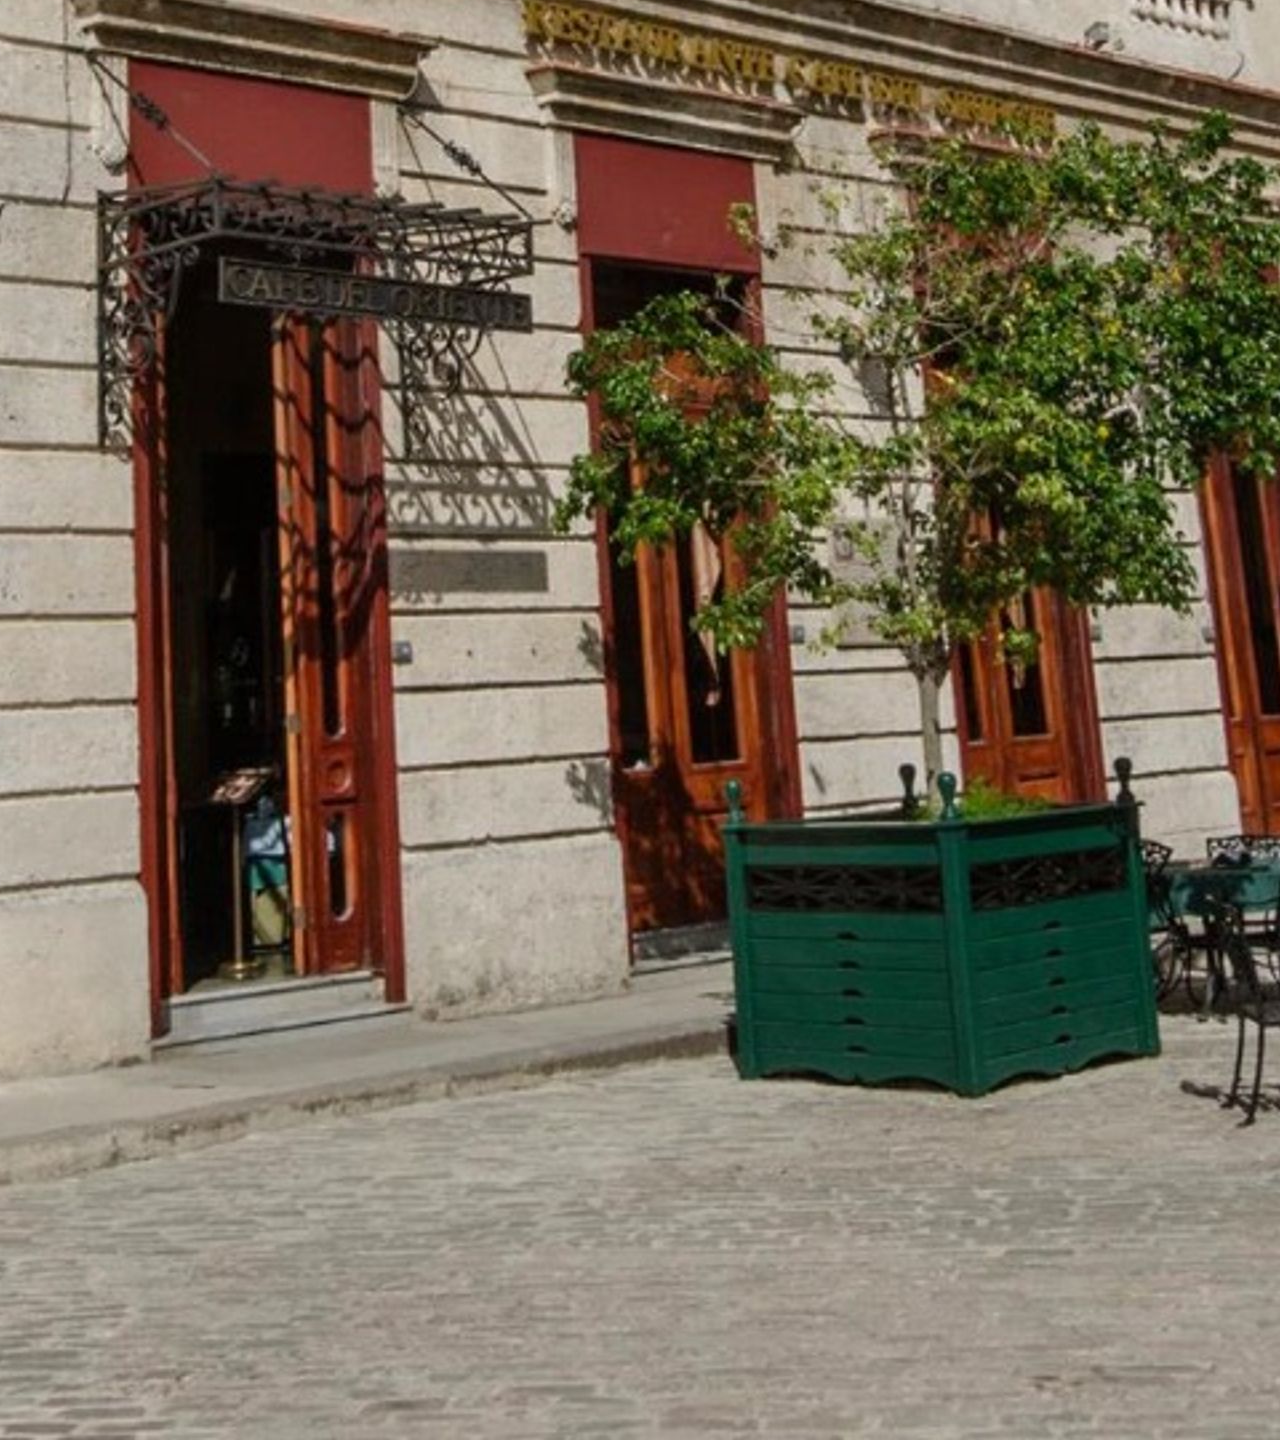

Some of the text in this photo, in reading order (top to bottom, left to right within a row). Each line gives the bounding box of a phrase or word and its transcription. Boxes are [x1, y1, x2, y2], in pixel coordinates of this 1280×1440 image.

[869, 72, 921, 109] DEL
[226, 266, 530, 328] CAFE DEL ORIENTE
